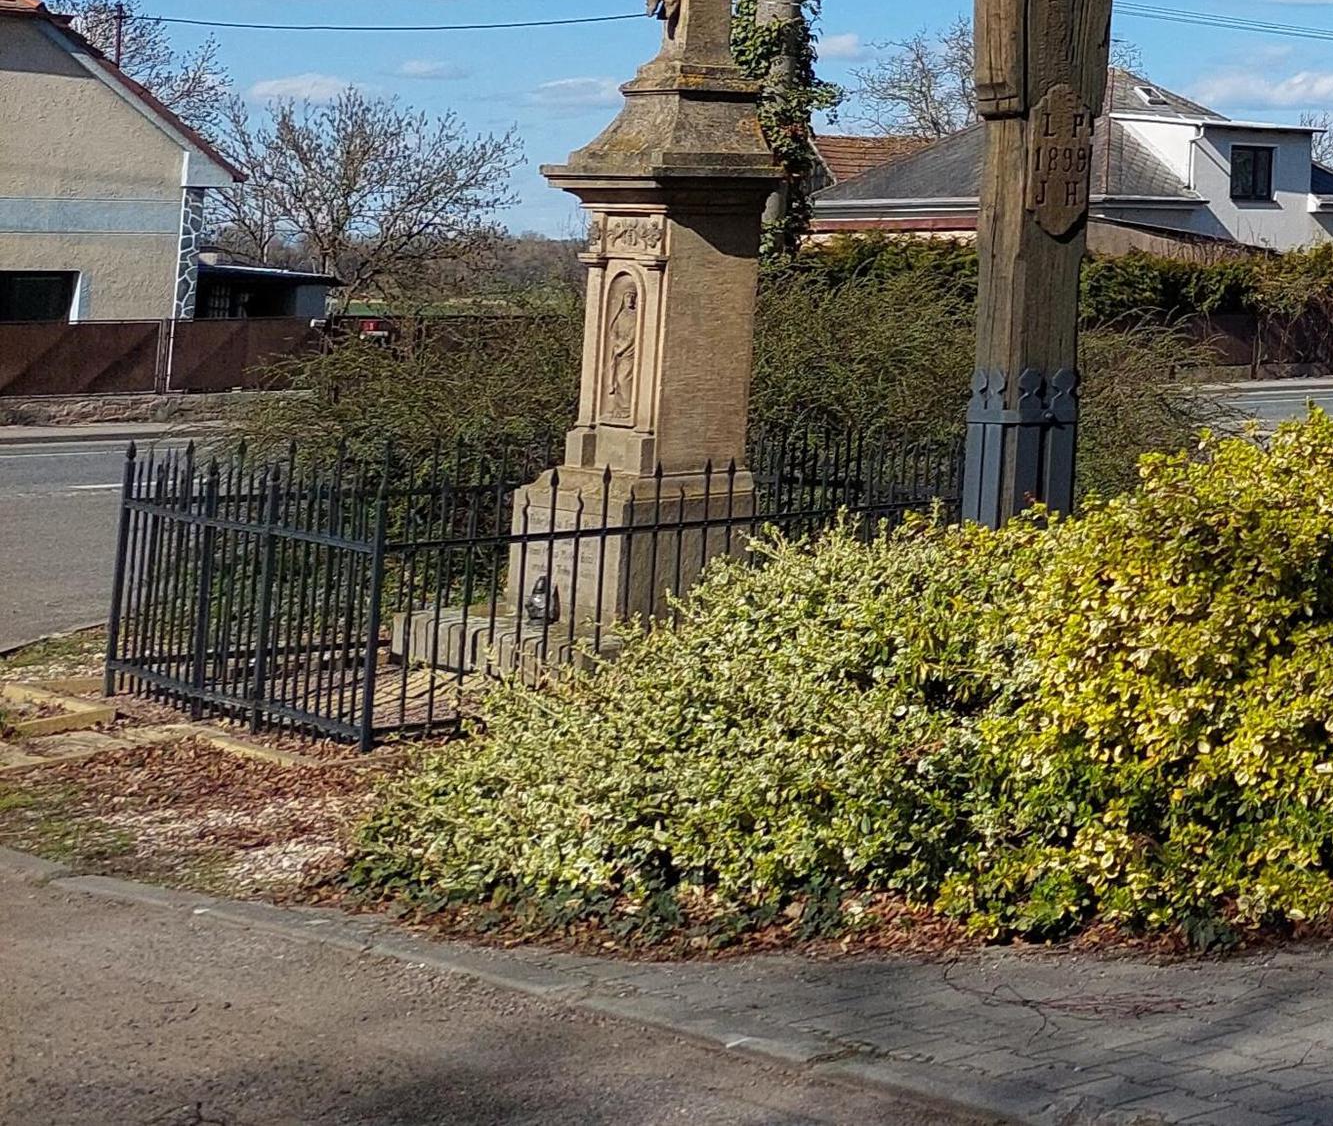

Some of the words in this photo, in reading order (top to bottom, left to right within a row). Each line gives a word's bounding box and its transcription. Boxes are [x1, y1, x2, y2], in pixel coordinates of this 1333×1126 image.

[1072, 113, 1084, 138] P
[1036, 181, 1047, 205] J
[1065, 181, 1078, 206] H
